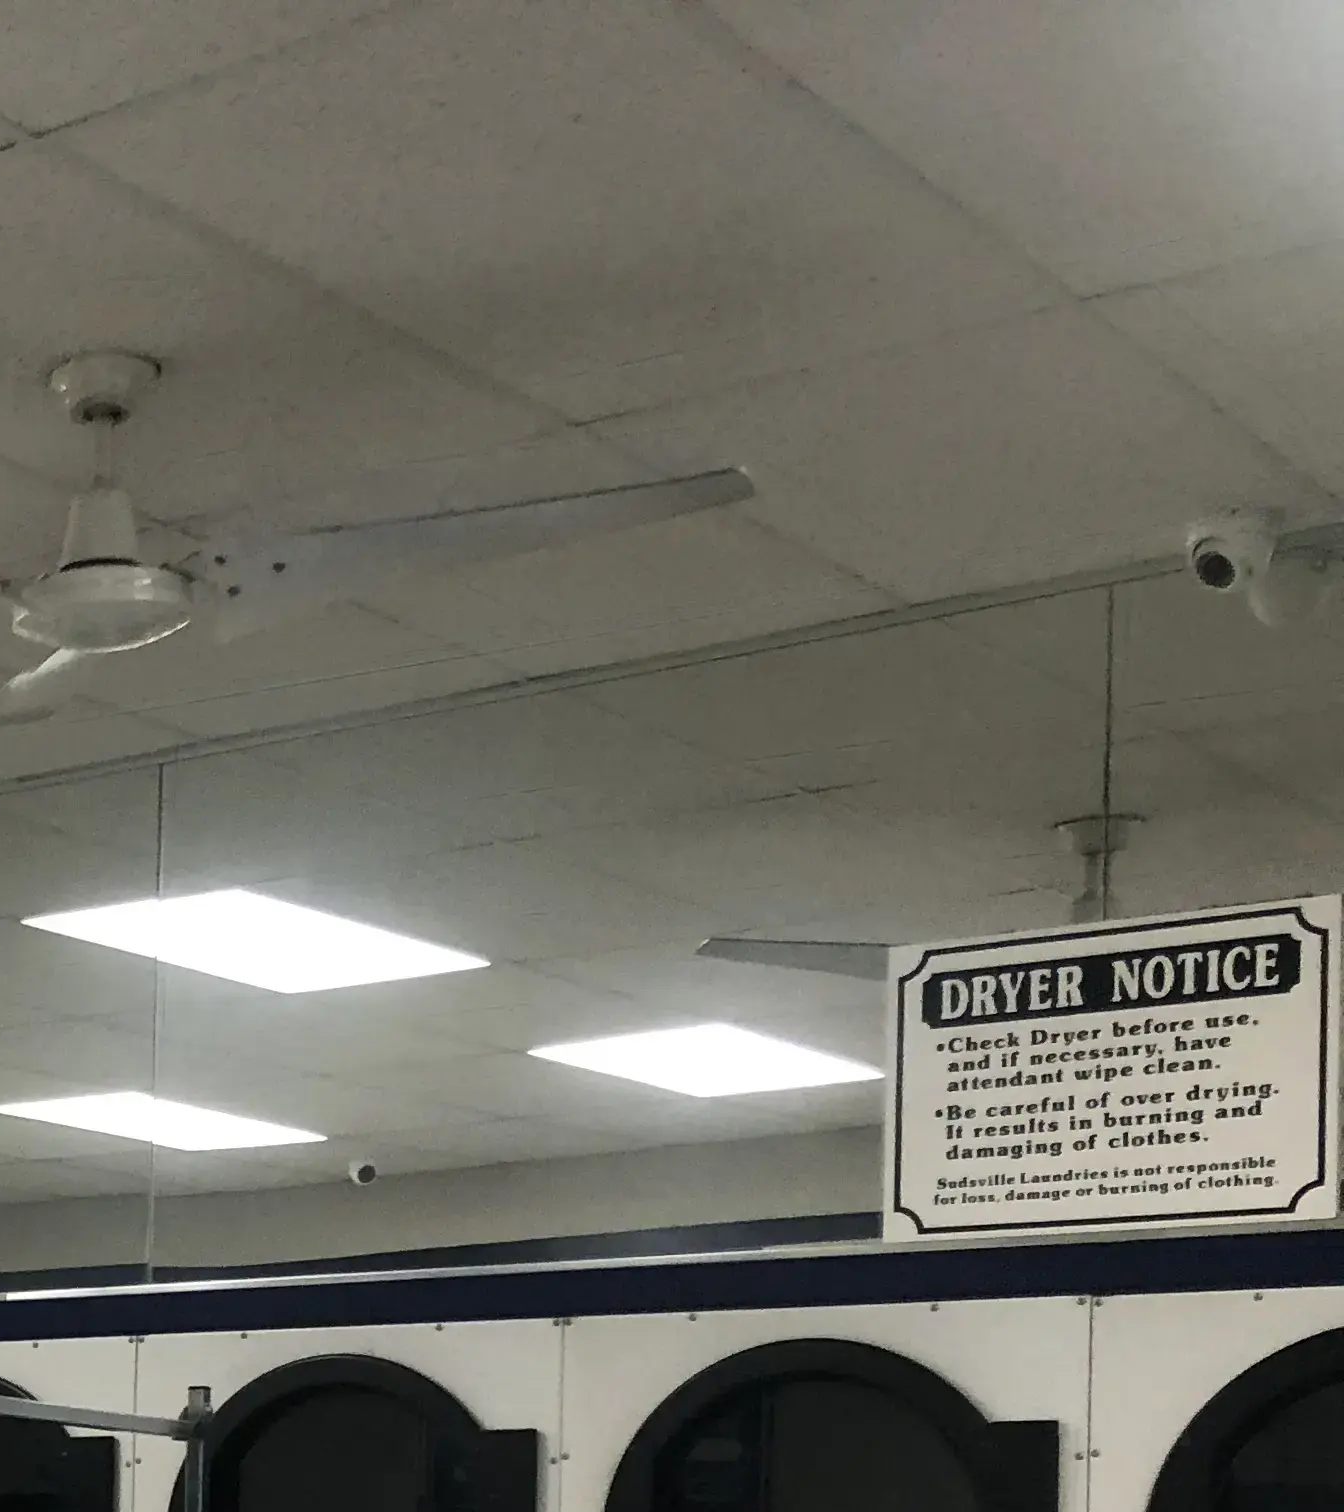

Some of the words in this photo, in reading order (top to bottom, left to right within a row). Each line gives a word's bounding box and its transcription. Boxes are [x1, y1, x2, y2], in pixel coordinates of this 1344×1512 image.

[939, 965, 1084, 1021] DRYER
[1111, 943, 1280, 1003] NOTICE
[1030, 1026, 1102, 1046] Dryer
[1111, 1018, 1195, 1039] before
[1205, 1012, 1260, 1029] use.
[947, 1054, 991, 1073] and
[1000, 1051, 1021, 1068] if
[1173, 1034, 1232, 1053] have
[946, 1069, 1064, 1093] attendant
[1073, 1063, 1134, 1083] wipe
[1142, 1056, 1221, 1075] clean.
[945, 1104, 977, 1122] Be
[985, 1095, 1076, 1119] careful
[1084, 1091, 1112, 1110] of
[1120, 1090, 1176, 1107] over
[1185, 1080, 1280, 1102] drying.
[944, 1124, 964, 1140] It
[973, 1117, 1060, 1139] results
[1069, 1115, 1093, 1131] in
[1102, 1107, 1205, 1129] burning
[1214, 1101, 1263, 1118] and
[945, 1139, 1063, 1161] damaging
[1072, 1134, 1098, 1152] of
[1107, 1129, 1210, 1150] clothes.
[932, 1193, 958, 1206] for
[1004, 1187, 1071, 1203] damage
[1074, 1186, 1094, 1198] or
[1098, 1181, 1170, 1197] burning
[1173, 1177, 1193, 1192] of
[936, 1173, 1017, 1191] Sudsville
[1019, 1168, 1109, 1186] Laundries
[1113, 1165, 1129, 1180] is
[1133, 1164, 1162, 1178] not
[1166, 1156, 1277, 1176] responsible
